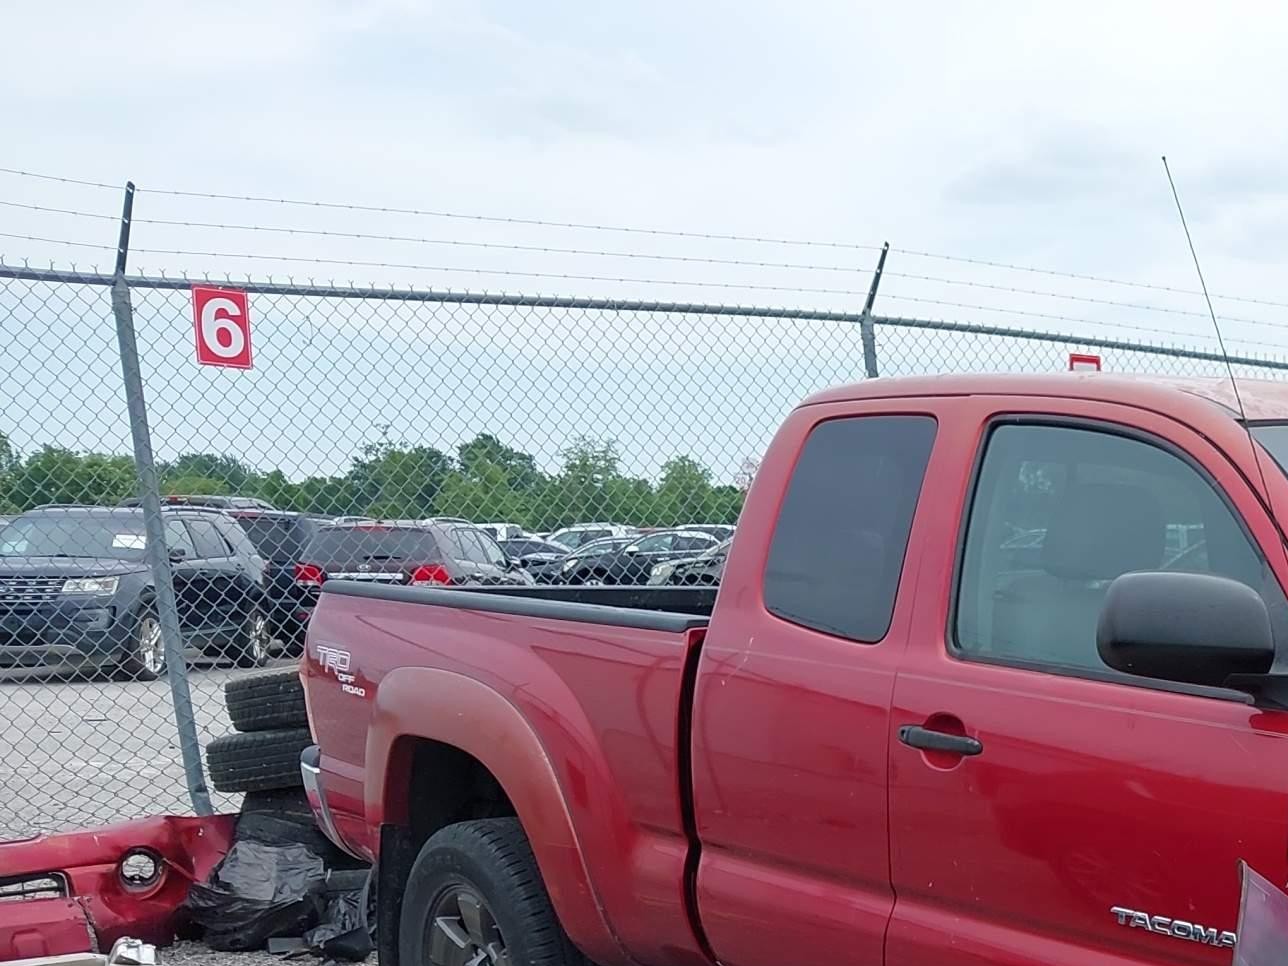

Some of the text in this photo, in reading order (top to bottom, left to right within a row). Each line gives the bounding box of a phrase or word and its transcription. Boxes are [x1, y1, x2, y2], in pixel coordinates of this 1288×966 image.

[201, 297, 245, 358] 6
[316, 645, 351, 675] TRD
[338, 673, 356, 684] OFF
[342, 684, 366, 697] ROAD
[1110, 906, 1238, 948] TACOMA
